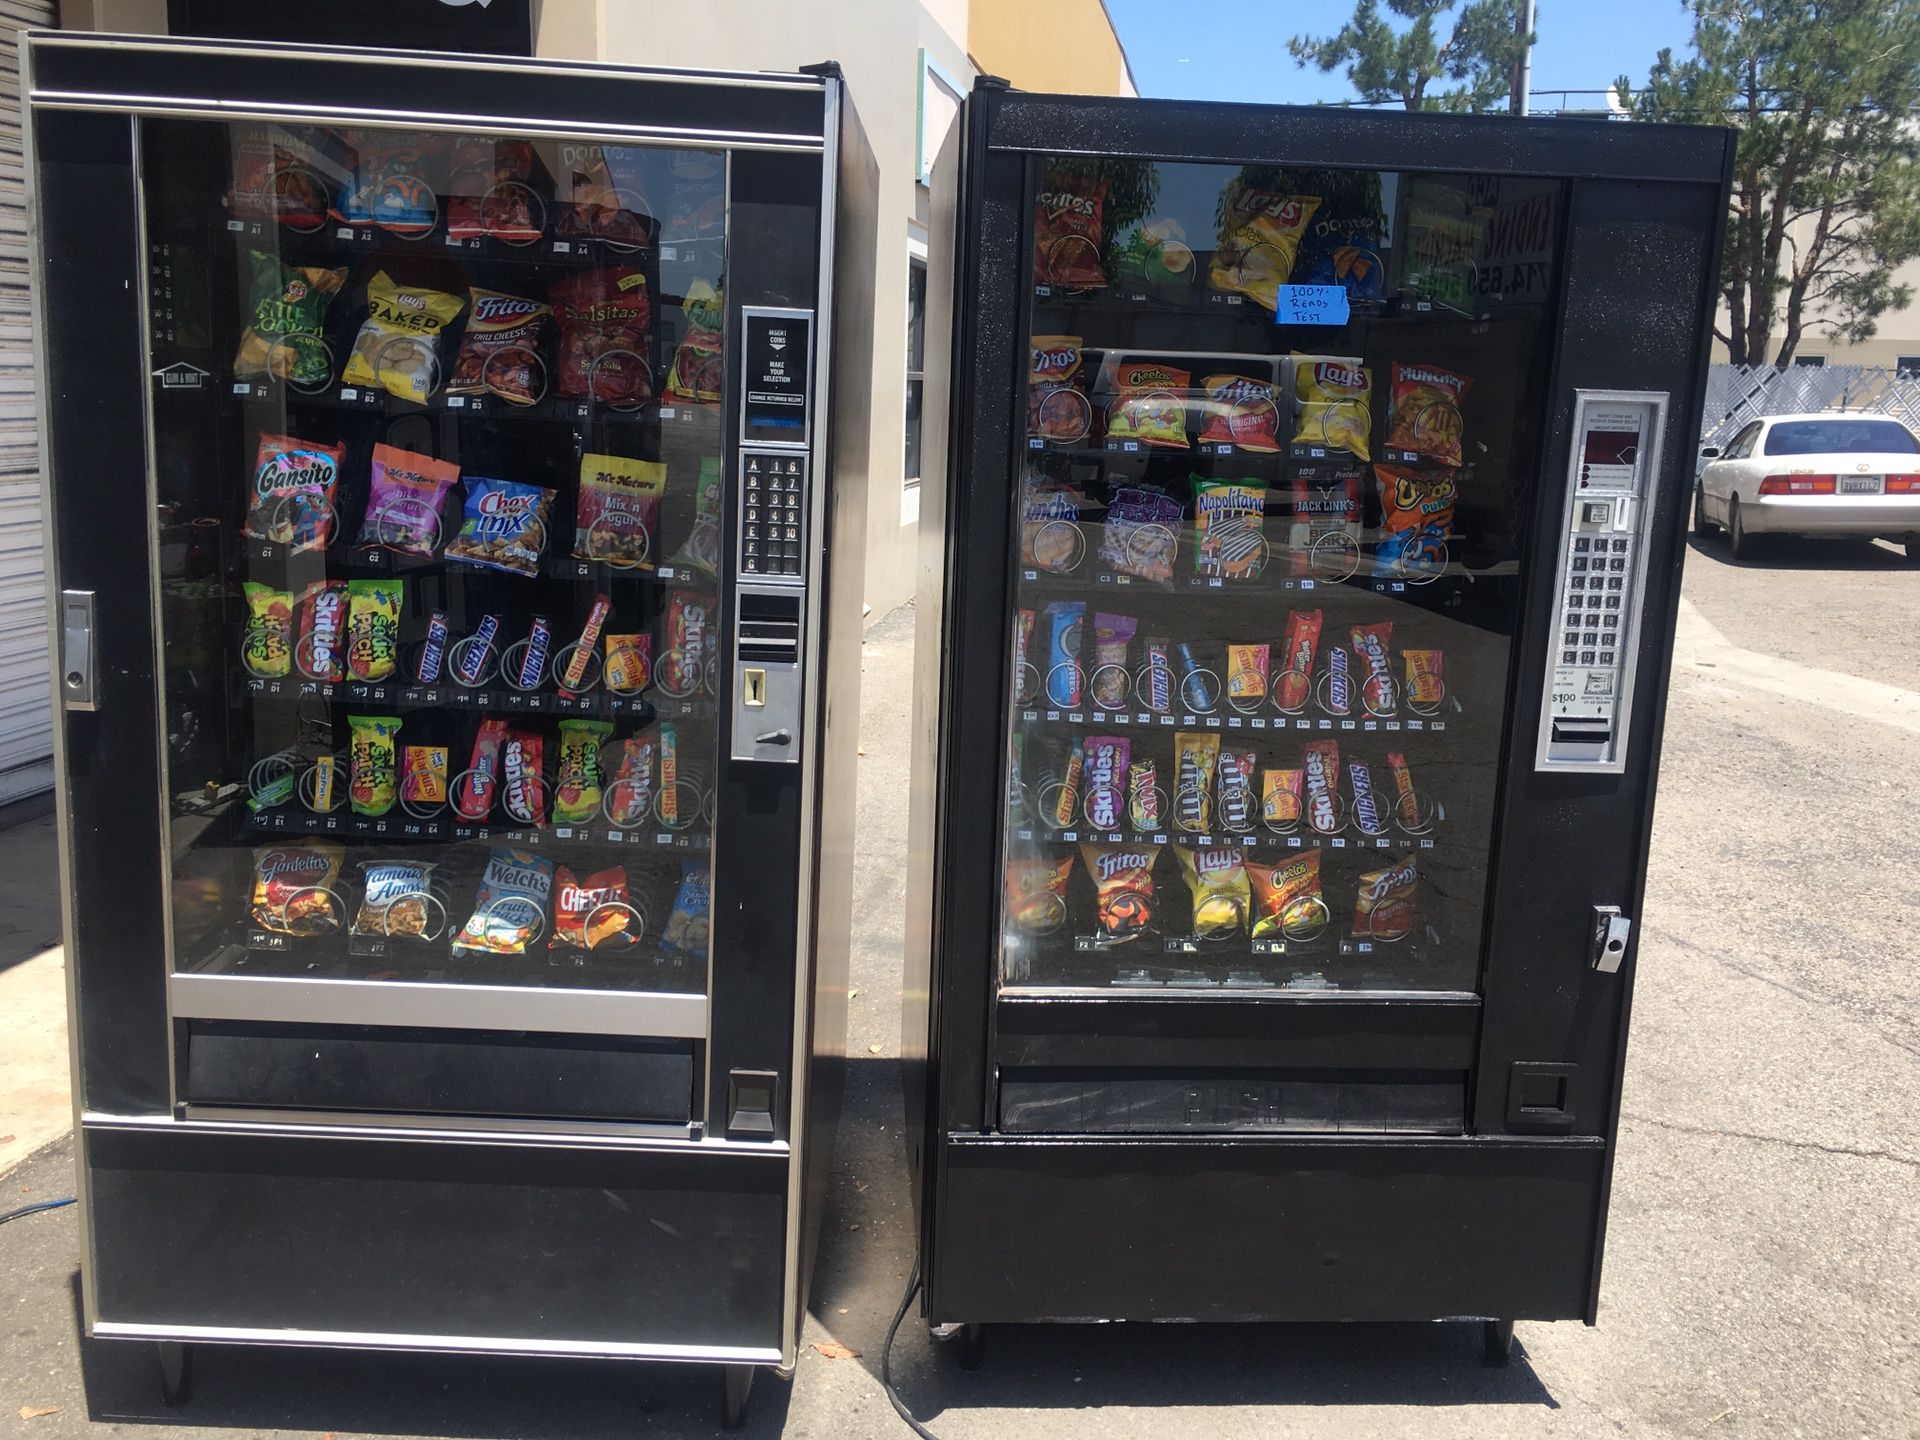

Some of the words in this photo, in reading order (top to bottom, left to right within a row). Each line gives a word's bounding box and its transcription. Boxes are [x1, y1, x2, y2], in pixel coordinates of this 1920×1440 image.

[369, 300, 439, 329] BAKED
[476, 298, 539, 321] Fritos
[473, 332, 493, 342] CHILI
[493, 327, 527, 341] CHEESE
[768, 329, 787, 337] INSERT
[769, 361, 785, 369] MAKE
[770, 368, 784, 376] YOUR
[1128, 368, 1172, 386] Cheetos
[1320, 361, 1364, 387] Lay's
[763, 375, 791, 383] SELECTION
[258, 389, 267, 397] B1
[364, 395, 375, 403] B2
[751, 460, 757, 470] A
[774, 461, 779, 471] 1
[789, 462, 796, 472] 6
[258, 462, 334, 494] Gansito
[616, 475, 656, 490] Nature
[750, 476, 757, 487] B
[773, 478, 779, 488] 2
[789, 479, 795, 488] 7
[479, 490, 537, 515] Chex
[605, 496, 626, 510] Mix
[750, 493, 756, 503] C
[772, 494, 778, 504] 3
[789, 495, 795, 505] 8
[1199, 487, 1265, 519] Napolitano
[1297, 500, 1322, 512] JACK
[1323, 499, 1355, 511] LINK'S
[749, 509, 756, 520] D
[771, 511, 778, 521] 4
[788, 511, 795, 522] 9
[749, 526, 755, 537] E
[771, 527, 777, 537] 5
[786, 528, 796, 538] 10
[262, 549, 272, 557] C1
[748, 543, 755, 553] F
[369, 554, 379, 562] C2
[748, 559, 755, 569] G
[1330, 646, 1348, 709] SNICKERS
[270, 685, 280, 693] D1
[323, 688, 333, 696] D2
[375, 691, 385, 699] D3
[427, 693, 437, 701] D4
[580, 700, 590, 708] D7
[1137, 766, 1158, 818] TWIX
[1306, 750, 1335, 830] Skittles
[1351, 765, 1380, 833] SNICKERS
[258, 851, 331, 885] Gardetto's
[1096, 852, 1148, 880] Fritos
[366, 866, 424, 884] Famous
[490, 861, 549, 893] Welch's
[1271, 862, 1308, 890] Cheetos
[373, 881, 424, 902] Amos
